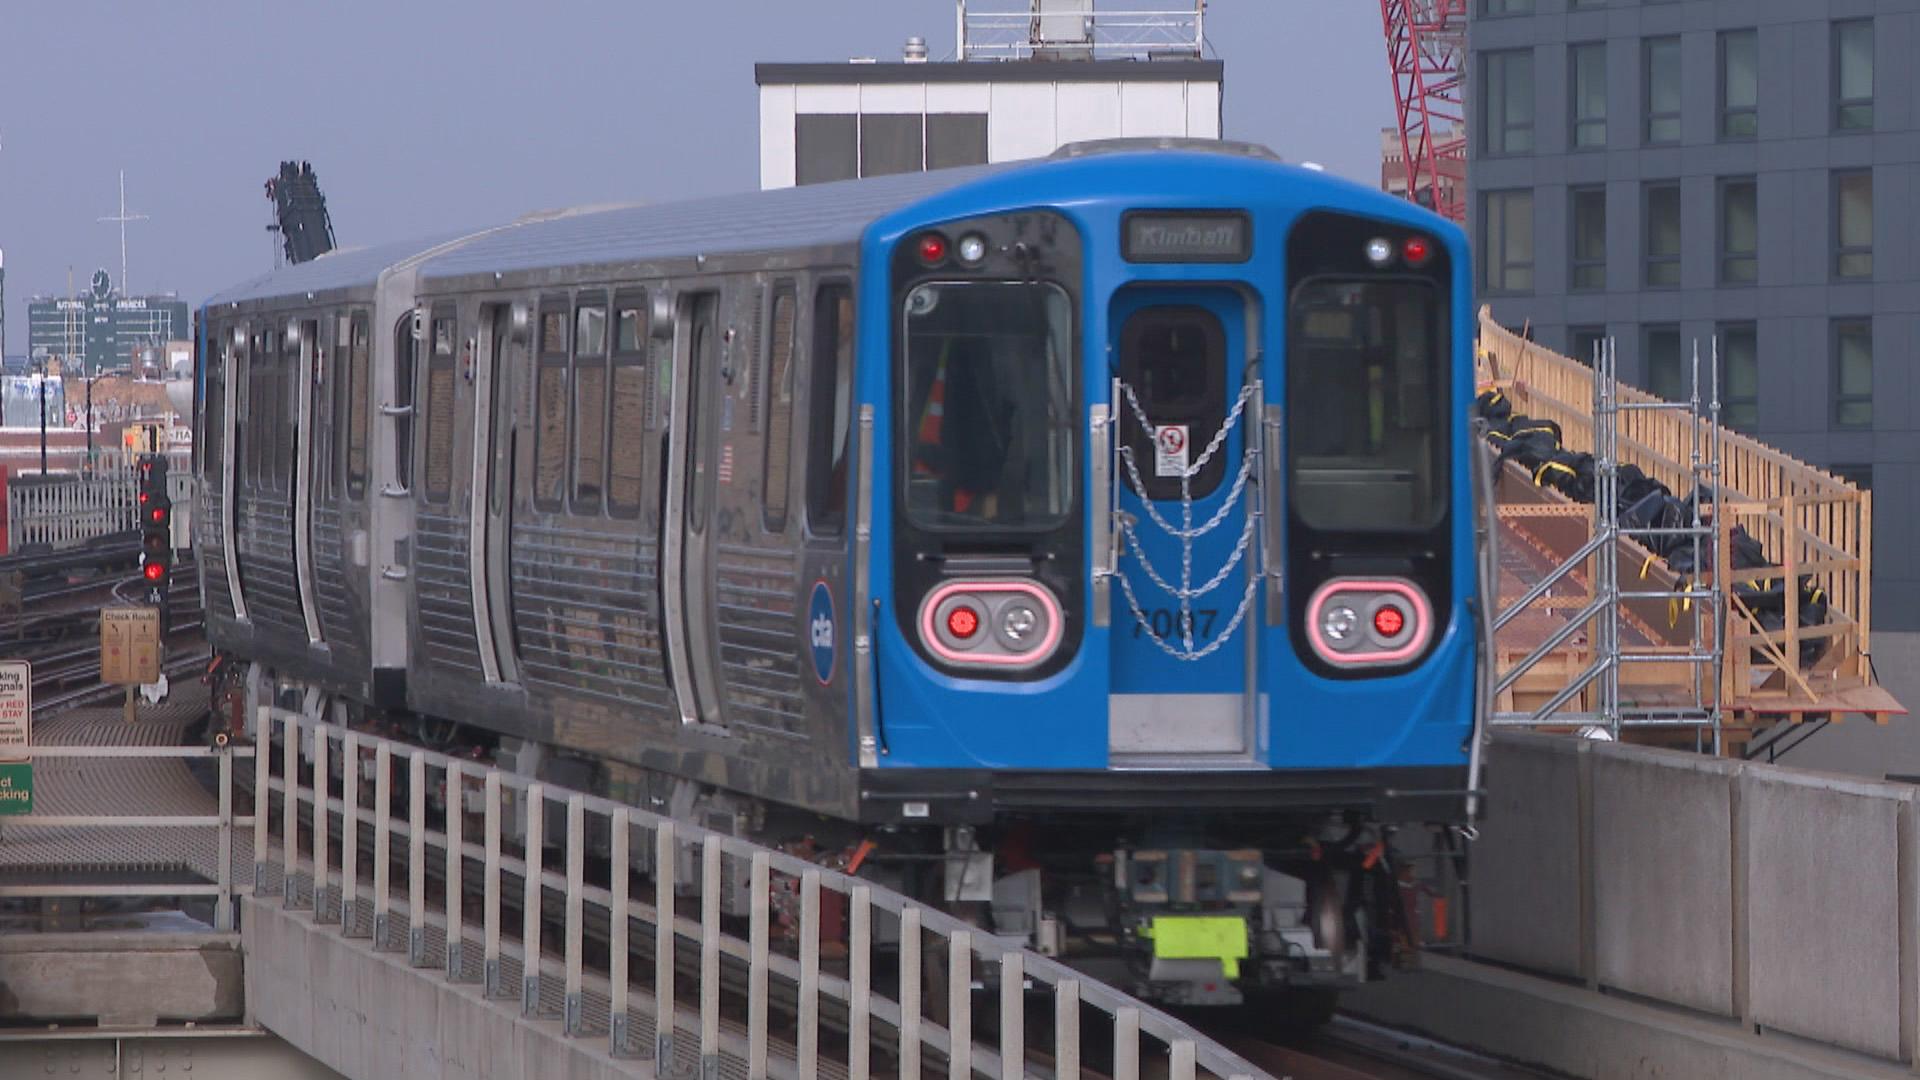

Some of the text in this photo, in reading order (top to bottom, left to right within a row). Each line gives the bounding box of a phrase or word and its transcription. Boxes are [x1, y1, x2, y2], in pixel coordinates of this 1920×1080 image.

[1140, 225, 1234, 246] Kimball
[811, 613, 833, 648] cta
[1130, 608, 1217, 639] 7007
[6, 701, 24, 709] RED
